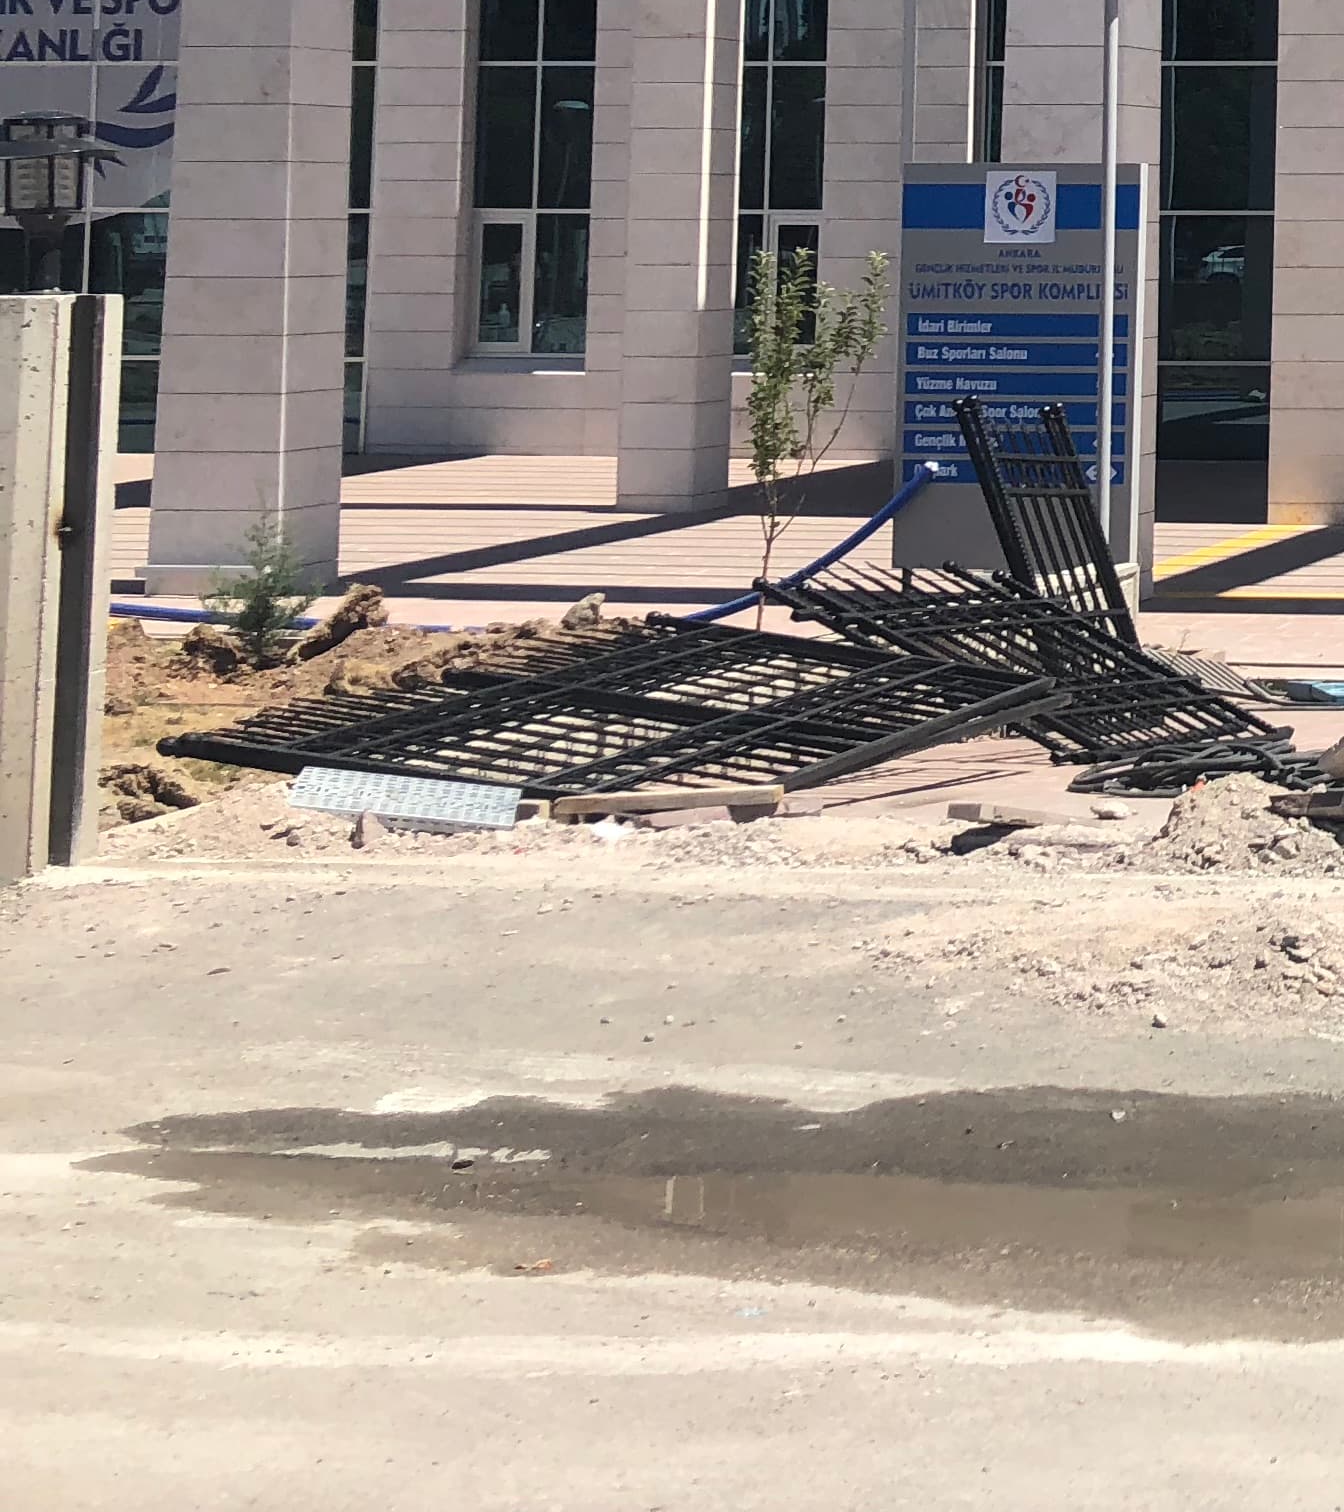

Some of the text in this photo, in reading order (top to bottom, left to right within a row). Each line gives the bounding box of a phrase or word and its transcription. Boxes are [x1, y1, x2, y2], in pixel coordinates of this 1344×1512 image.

[991, 282, 1033, 300] SPOR
[917, 346, 938, 359] Buz
[989, 347, 1028, 360] Salonu
[955, 377, 997, 391] Havuzu
